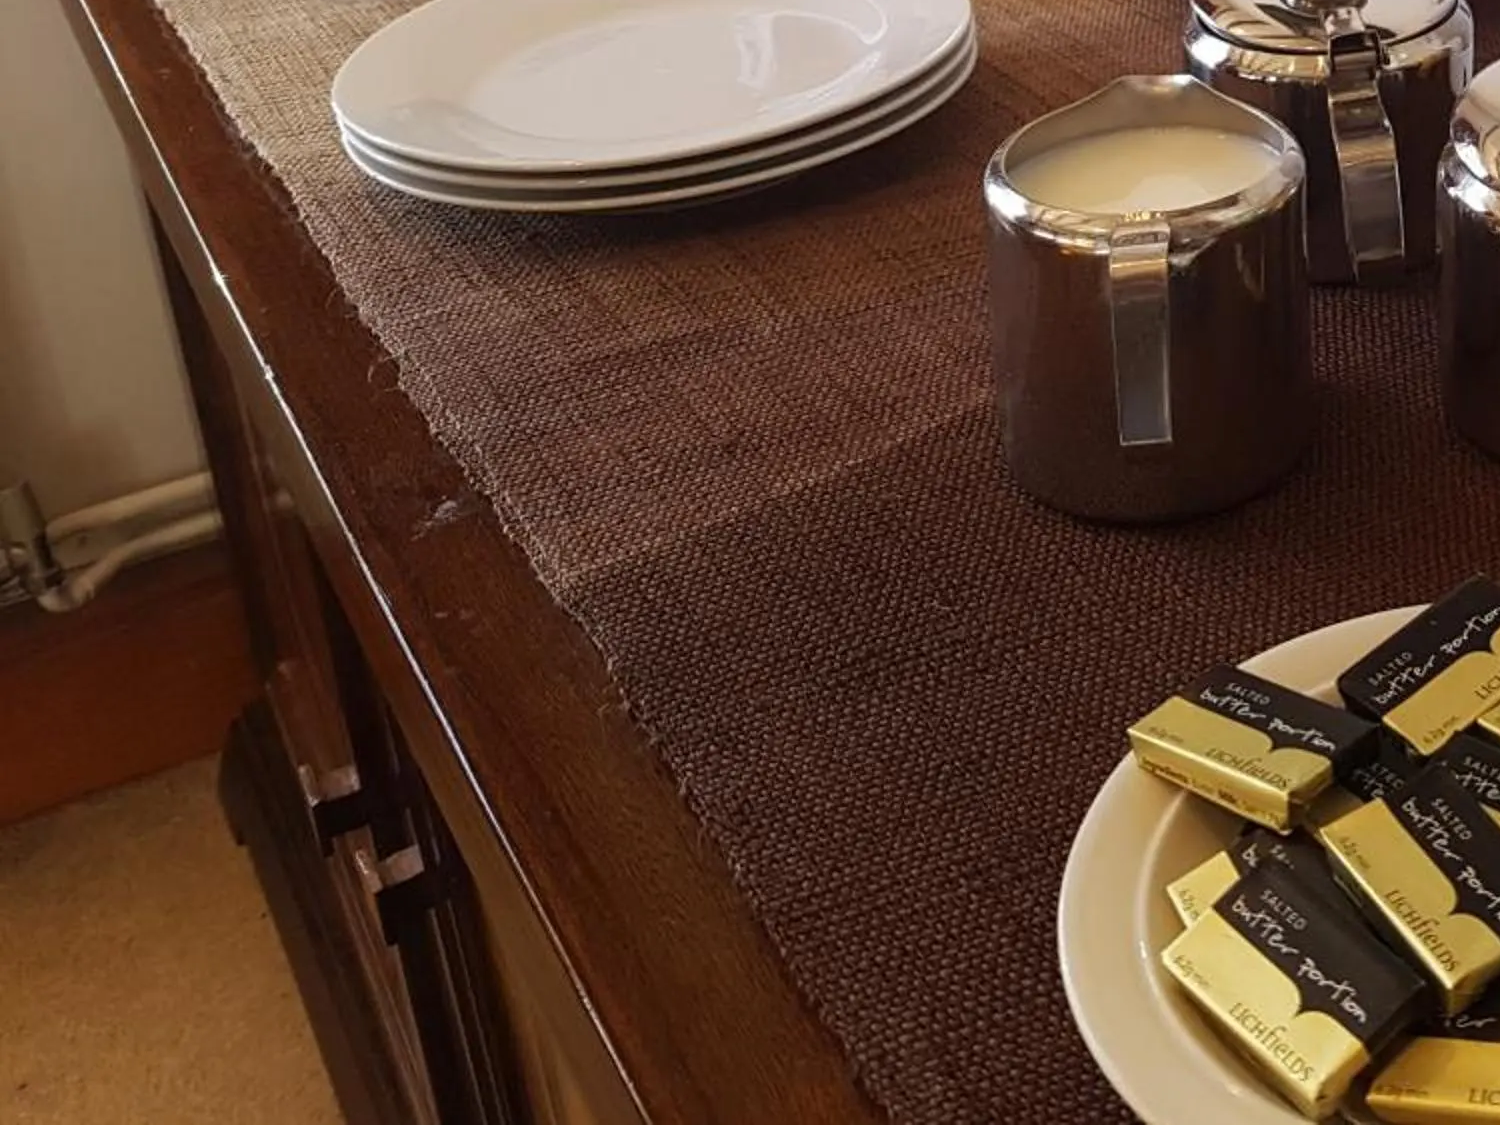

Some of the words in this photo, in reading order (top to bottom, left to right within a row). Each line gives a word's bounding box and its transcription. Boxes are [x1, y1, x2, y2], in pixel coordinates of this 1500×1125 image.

[1369, 651, 1412, 686] SALTED
[1373, 654, 1436, 705] butter
[1226, 682, 1271, 705] SALTED
[1200, 686, 1267, 718] butter
[1269, 717, 1336, 751] portion
[1401, 796, 1464, 862] butter
[1431, 797, 1473, 841] SALTED
[1260, 888, 1307, 931] SALTED
[1232, 894, 1299, 956] butter
[1297, 957, 1367, 1024] portion
